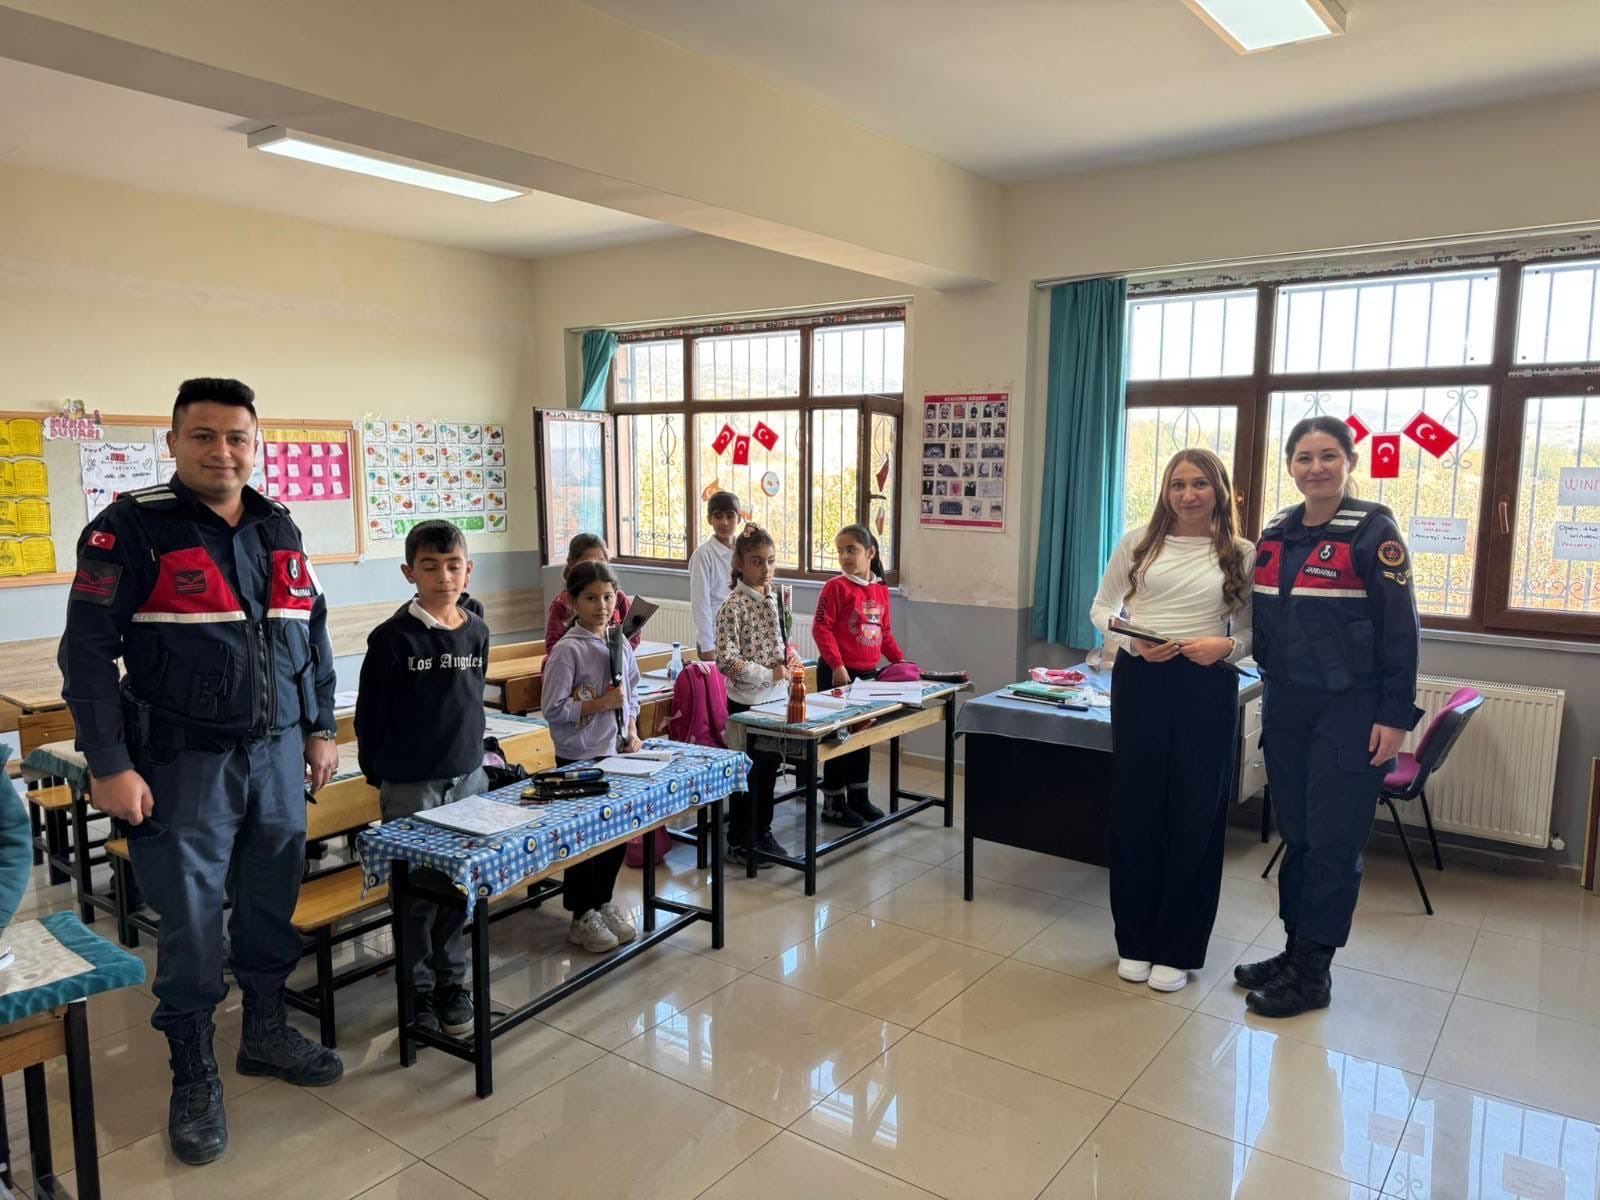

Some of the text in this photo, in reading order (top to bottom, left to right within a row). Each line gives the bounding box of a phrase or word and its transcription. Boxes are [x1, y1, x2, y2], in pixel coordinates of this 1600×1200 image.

[50, 417, 95, 428] MERAK
[50, 428, 100, 440] DUVARI
[1559, 524, 1578, 535] Open
[1305, 566, 1337, 578] JANDARMA
[407, 653, 483, 672] Los Angeles
